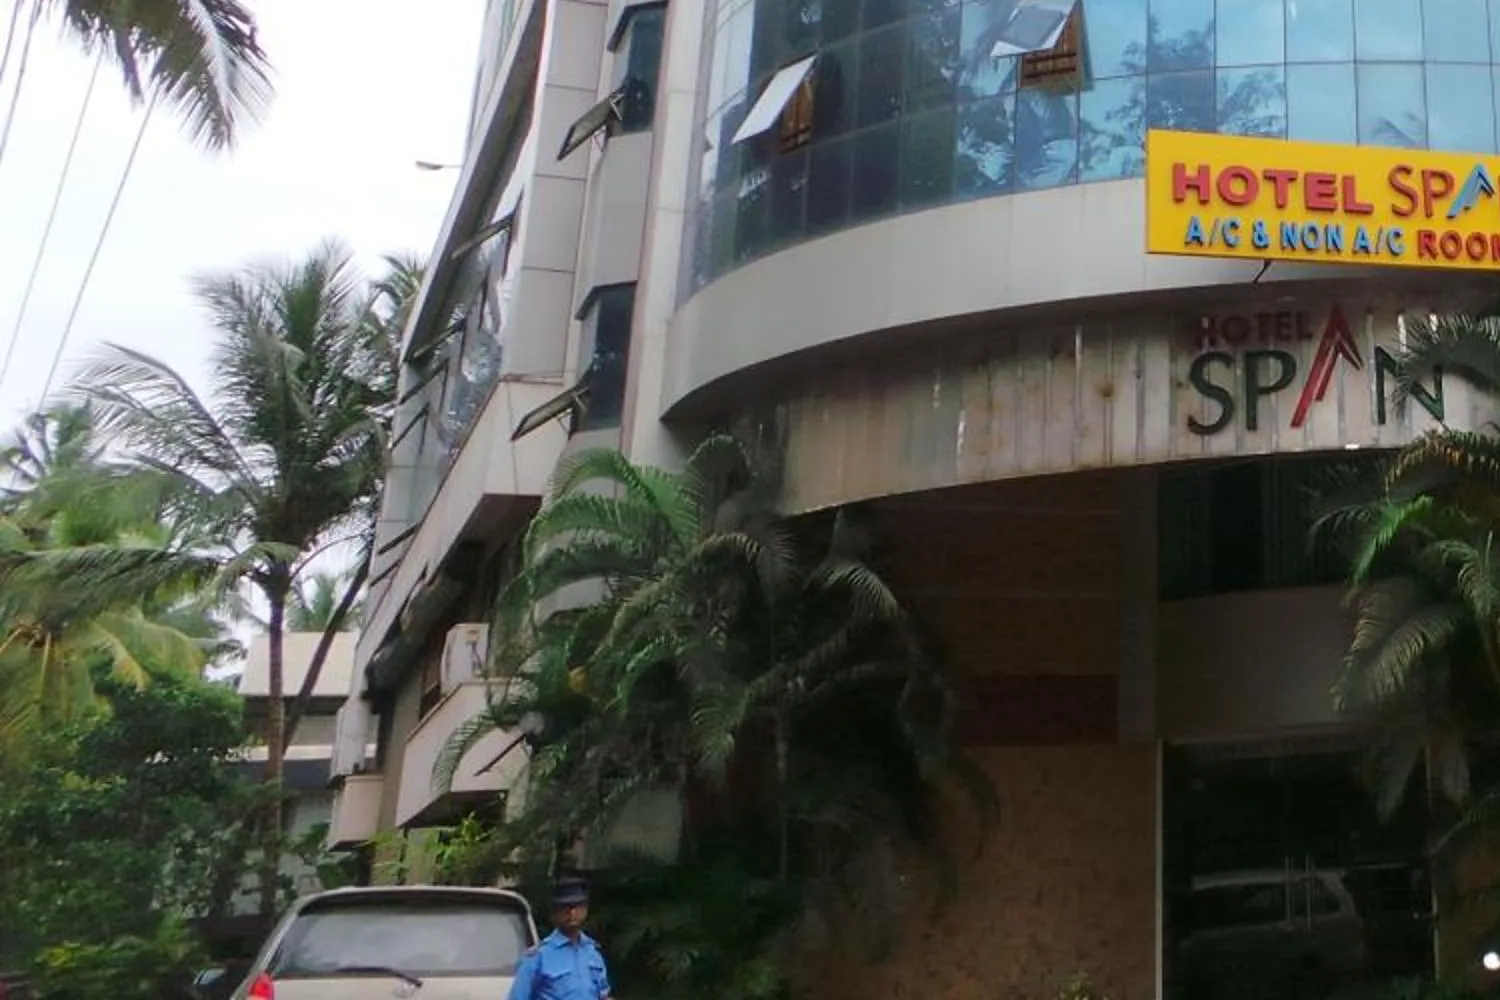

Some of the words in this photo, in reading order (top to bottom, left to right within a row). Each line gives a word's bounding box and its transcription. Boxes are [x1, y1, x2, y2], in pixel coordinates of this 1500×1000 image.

[1171, 161, 1374, 216] HOTEL
[1184, 216, 1241, 248] A/C
[1251, 220, 1272, 250] &
[1279, 221, 1345, 255] NON
[1352, 226, 1406, 257] A/C
[1194, 309, 1314, 348] HOTEL
[1187, 302, 1445, 436] SPAN
